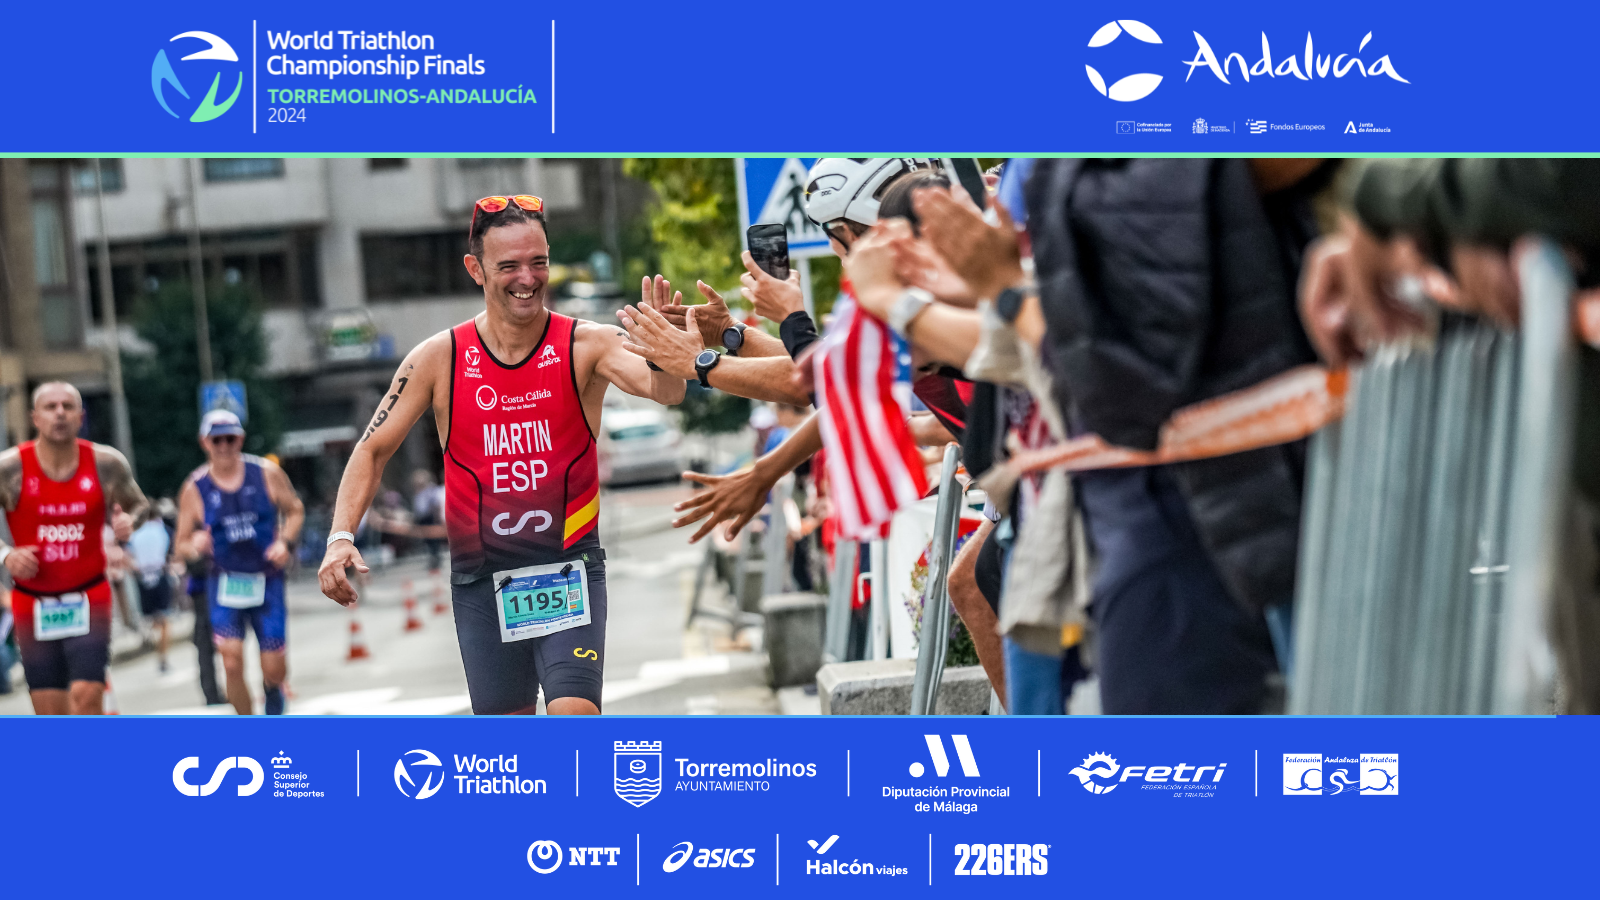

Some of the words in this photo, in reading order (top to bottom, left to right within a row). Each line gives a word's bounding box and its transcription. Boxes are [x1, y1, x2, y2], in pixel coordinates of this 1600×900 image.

[501, 395, 524, 404] Costa
[525, 389, 552, 401] Cálida
[483, 419, 552, 456] MARTIN
[492, 459, 548, 493] ESP
[509, 590, 564, 613] 1195
